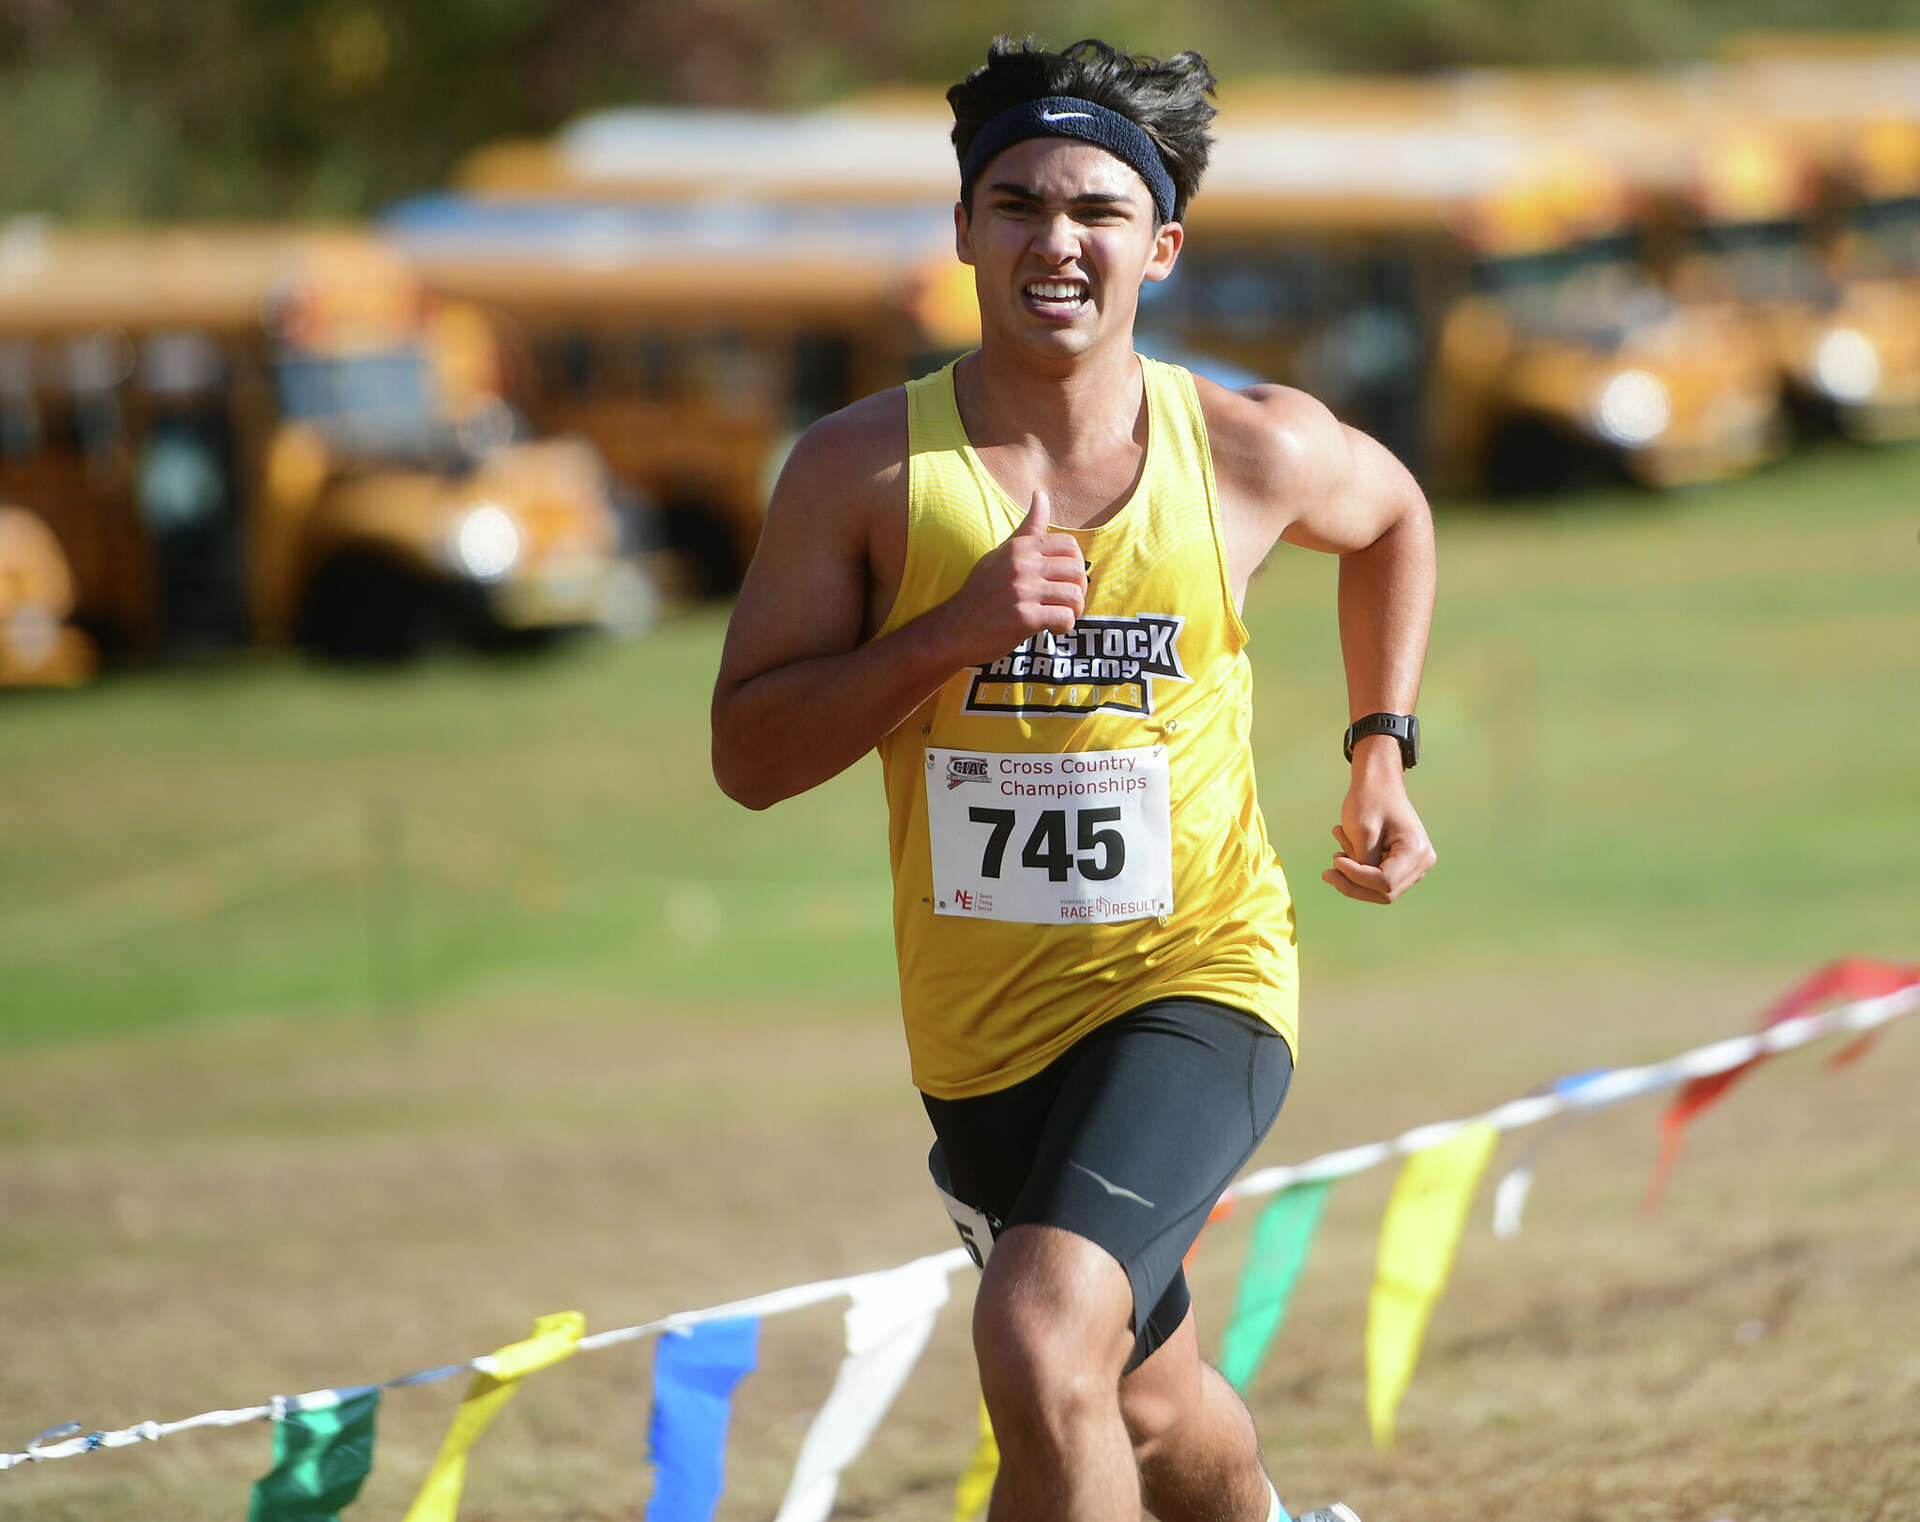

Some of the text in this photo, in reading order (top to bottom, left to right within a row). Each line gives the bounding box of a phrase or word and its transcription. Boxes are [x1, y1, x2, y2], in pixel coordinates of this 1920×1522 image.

[990, 655, 1140, 679] ACADEMY
[1000, 755, 1136, 775] Cross Country
[1000, 776, 1147, 799] Championships
[968, 806, 1126, 883] 745
[1061, 899, 1157, 919] RACE RESULT
